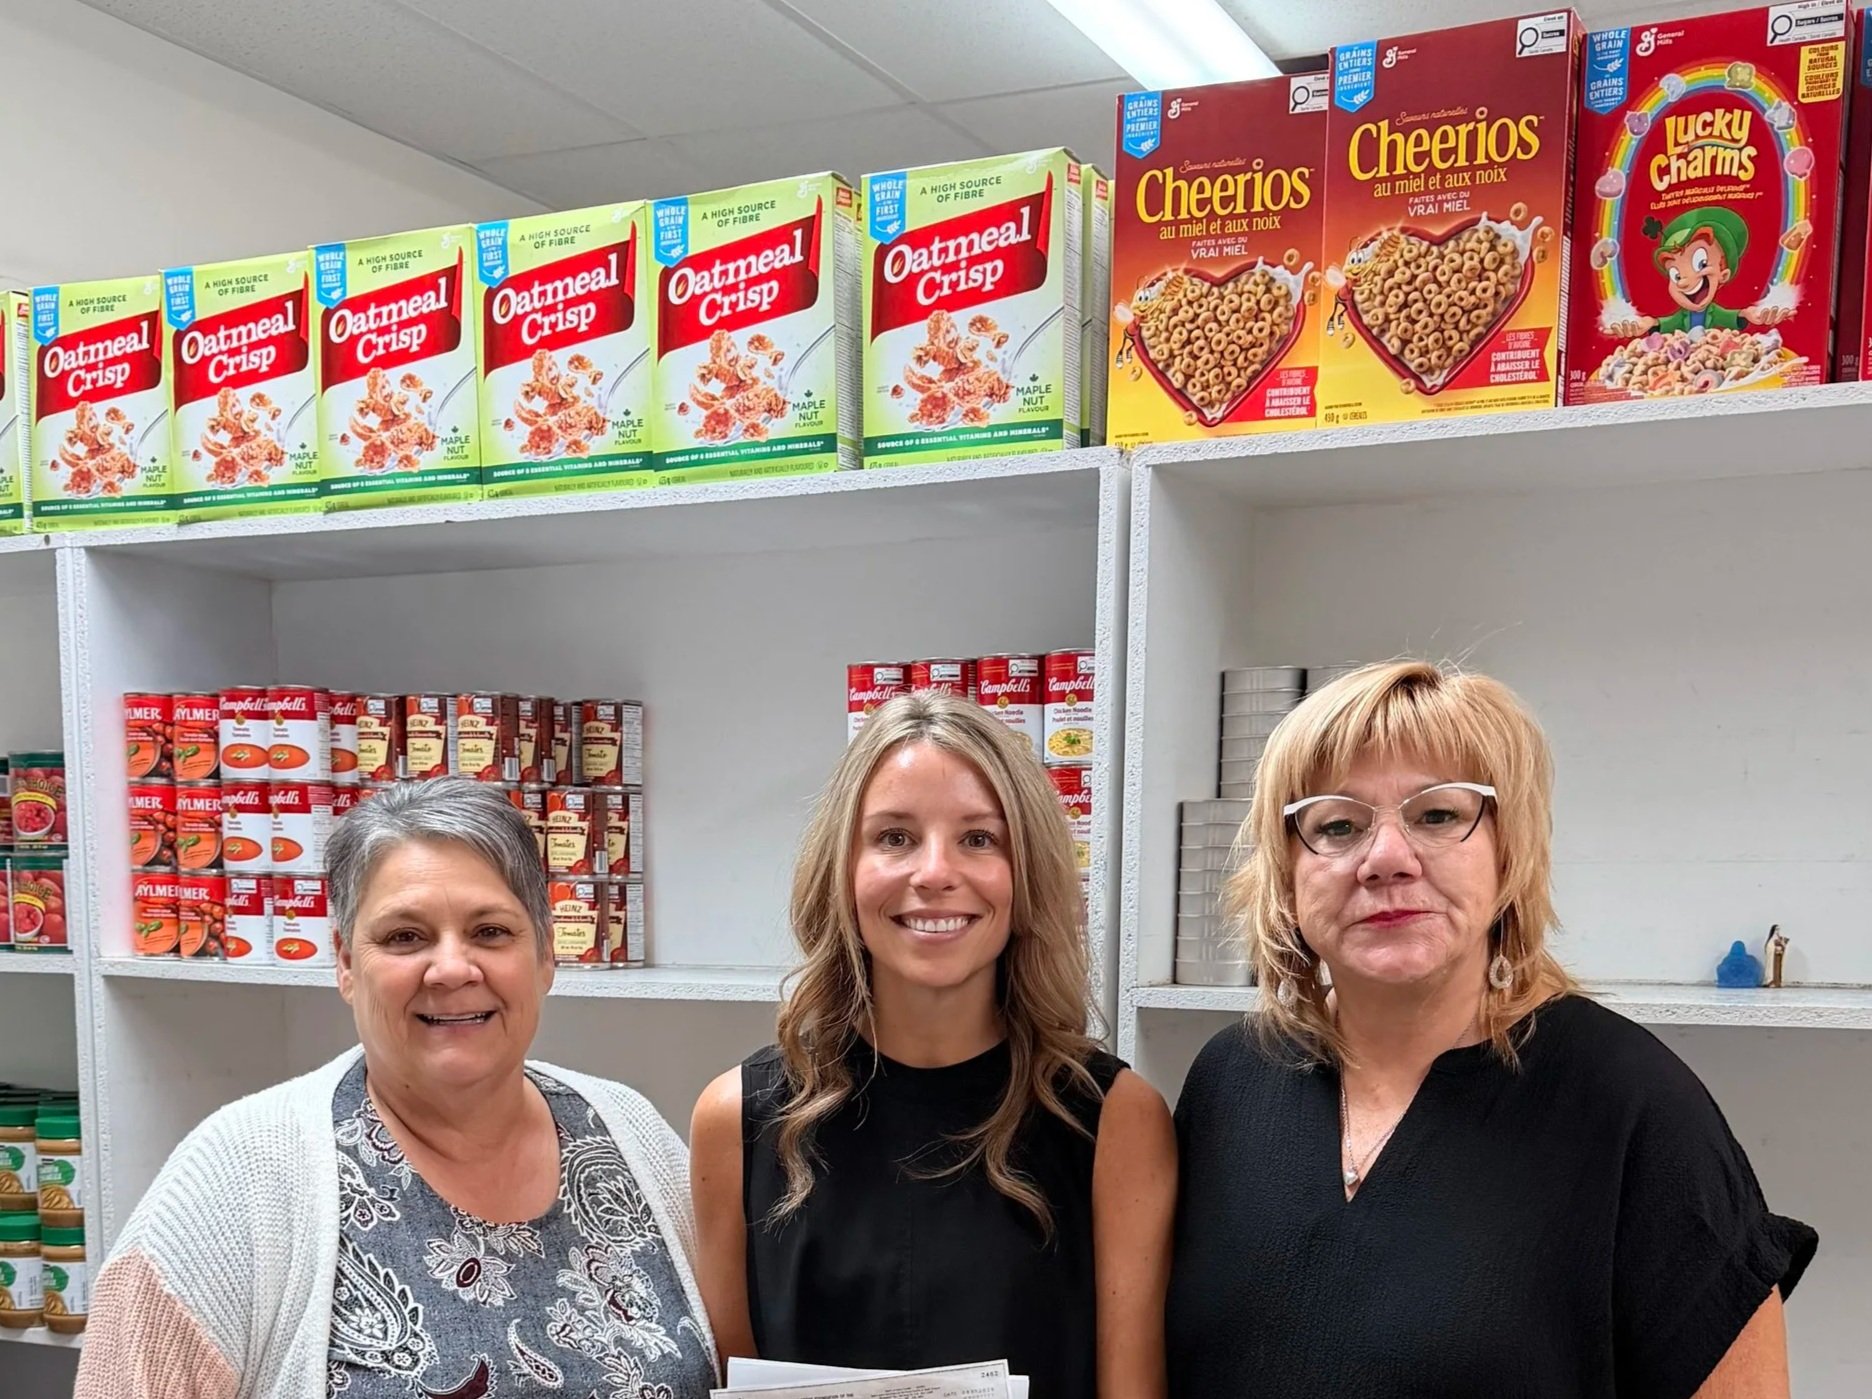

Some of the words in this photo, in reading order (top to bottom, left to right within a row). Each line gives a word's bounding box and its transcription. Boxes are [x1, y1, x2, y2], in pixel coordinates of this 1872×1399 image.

[1592, 30, 1628, 43] WHOLE
[1657, 30, 1684, 39] General
[1595, 40, 1623, 52] GRAIN
[1808, 44, 1839, 54] COLOURS
[1340, 48, 1372, 61] GRAINS
[1809, 55, 1836, 64] NATURAL
[1339, 58, 1371, 71] ENTIERS
[1807, 62, 1837, 71] SOURCES
[1338, 72, 1371, 86] PREMIER
[1805, 72, 1838, 81] COULEURS
[1590, 77, 1624, 90] GRAINS
[1806, 82, 1836, 92] SOURCES
[1589, 87, 1623, 100] ENTIERS
[1801, 88, 1840, 99] NATURELLES
[1128, 99, 1158, 110] GRAINS
[1127, 108, 1158, 119] ENTIERS
[1126, 121, 1157, 132] PREMIER
[1665, 108, 1752, 156] Lucky
[1349, 107, 1540, 181] Cheerios
[1650, 145, 1758, 191] Charms
[872, 180, 904, 192] WHOLE
[920, 187, 927, 195] A
[931, 183, 956, 193] HIGH
[960, 176, 1001, 190] SOURCE
[1374, 183, 1390, 197] au
[1395, 174, 1424, 194] miel
[1428, 173, 1441, 191] et
[1445, 172, 1471, 188] aux
[1476, 165, 1507, 184] noix
[875, 190, 900, 202] GRAIN
[937, 193, 950, 203] OF
[954, 189, 984, 200] FIBRE
[1136, 158, 1311, 223] Cheerios
[1408, 195, 1435, 205] FAITES
[1437, 193, 1457, 201] AVEC
[1459, 191, 1470, 199] DU
[656, 206, 686, 218] WHOLE
[701, 212, 707, 220] A
[711, 208, 734, 218] HIGH
[737, 200, 775, 214] SOURCE
[1408, 205, 1438, 217] VRAI
[1443, 200, 1471, 213] MIEL
[659, 215, 682, 226] GRAIN
[717, 217, 729, 227] OF
[732, 213, 760, 224] FIBRE
[1160, 226, 1175, 240] au
[1180, 219, 1206, 238] miel
[1210, 218, 1221, 235] et
[1225, 219, 1248, 233] aux
[1252, 212, 1281, 231] noix
[478, 228, 505, 239] WHOLE
[528, 231, 550, 240] HIGH
[553, 224, 590, 237] SOURCE
[481, 236, 502, 248] GRAIN
[534, 240, 545, 248] OF
[549, 236, 574, 246] FIBRE
[884, 206, 1031, 283] Oatmeal
[1192, 239, 1215, 247] FAITES
[317, 252, 344, 262] WHOLE
[366, 255, 386, 264] HIGH
[389, 250, 422, 261] SOURCE
[483, 250, 500, 260] FIRST
[1190, 248, 1219, 260] VRAI
[1223, 244, 1248, 257] MIEL
[320, 260, 341, 270] GRAIN
[371, 264, 382, 272] OF
[385, 261, 409, 270] FIBRE
[669, 229, 803, 304] Oatmeal
[212, 279, 232, 287] HIGH
[235, 274, 268, 285] SOURCE
[321, 273, 339, 282] FIRST
[916, 259, 1004, 305] Crisp
[218, 287, 228, 295] OF
[231, 284, 255, 294] FIBRE
[492, 252, 618, 323] Oatmeal
[76, 298, 94, 306] HIGH
[96, 295, 126, 304] SOURCE
[699, 280, 779, 325] Crisp
[80, 306, 90, 314] OF
[93, 304, 114, 312] FIBRE
[330, 277, 448, 343] Oatmeal
[521, 301, 596, 344] Crisp
[182, 300, 296, 363] Oatmeal
[44, 320, 149, 377] Oatmeal
[357, 322, 427, 363] Crisp
[208, 344, 276, 382] Crisp
[67, 360, 130, 396] Crisp
[1016, 384, 1052, 395] MAPLE
[792, 399, 825, 410] MAPLE
[1023, 397, 1043, 406] NUT
[798, 411, 818, 420] NUT
[611, 418, 643, 428] MAPLE
[440, 435, 470, 444] MAPLE
[618, 430, 636, 438] NUT
[289, 451, 318, 460] MAPLE
[446, 446, 464, 454] NUT
[140, 465, 166, 473] MAPLE
[980, 678, 1030, 696] Campbell's
[849, 685, 895, 703] Campbell's
[173, 708, 220, 720] AYLMER
[461, 720, 480, 728] HEINZ
[586, 726, 605, 734] HEINZ
[176, 798, 223, 811] AYLMER
[552, 815, 572, 823] HEINZ
[560, 904, 582, 913] HEINZ
